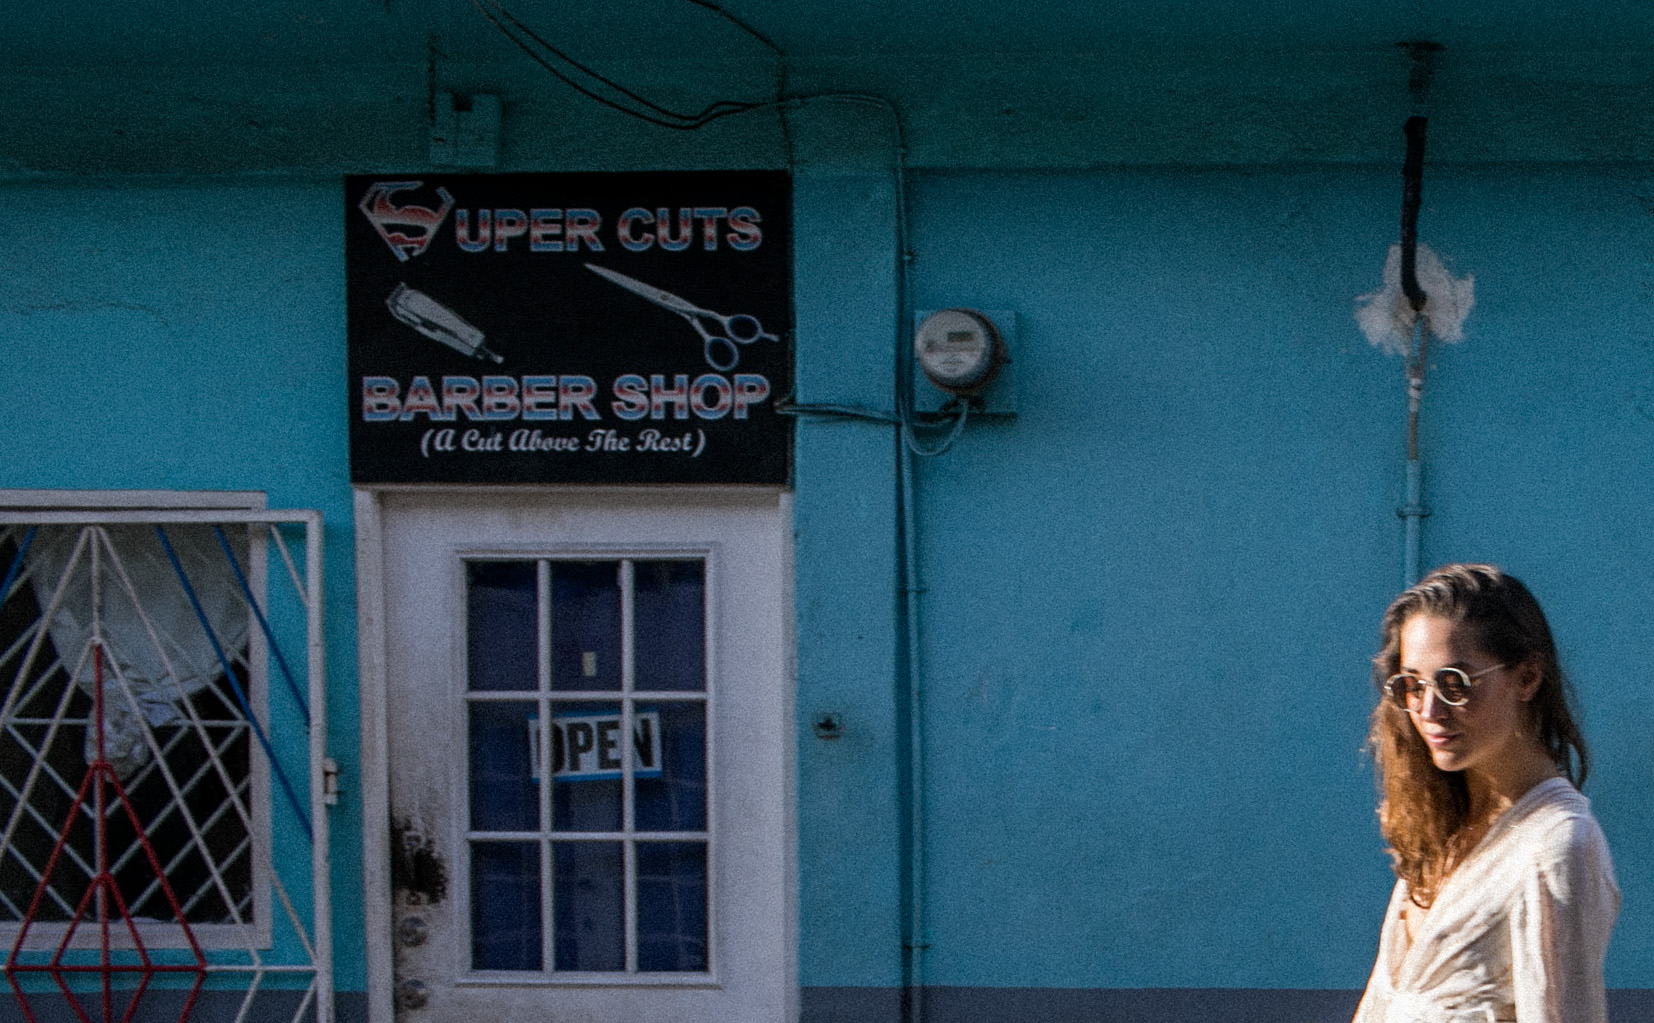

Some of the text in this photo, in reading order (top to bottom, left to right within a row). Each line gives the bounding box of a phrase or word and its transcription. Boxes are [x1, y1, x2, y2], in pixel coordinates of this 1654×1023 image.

[617, 206, 763, 253] CUTS
[362, 372, 771, 422] BARBER SHOP
[461, 429, 504, 452] Cut
[508, 428, 580, 452] Above
[584, 429, 631, 452] The
[635, 428, 707, 458] Rest)
[537, 717, 654, 774] OPEN
